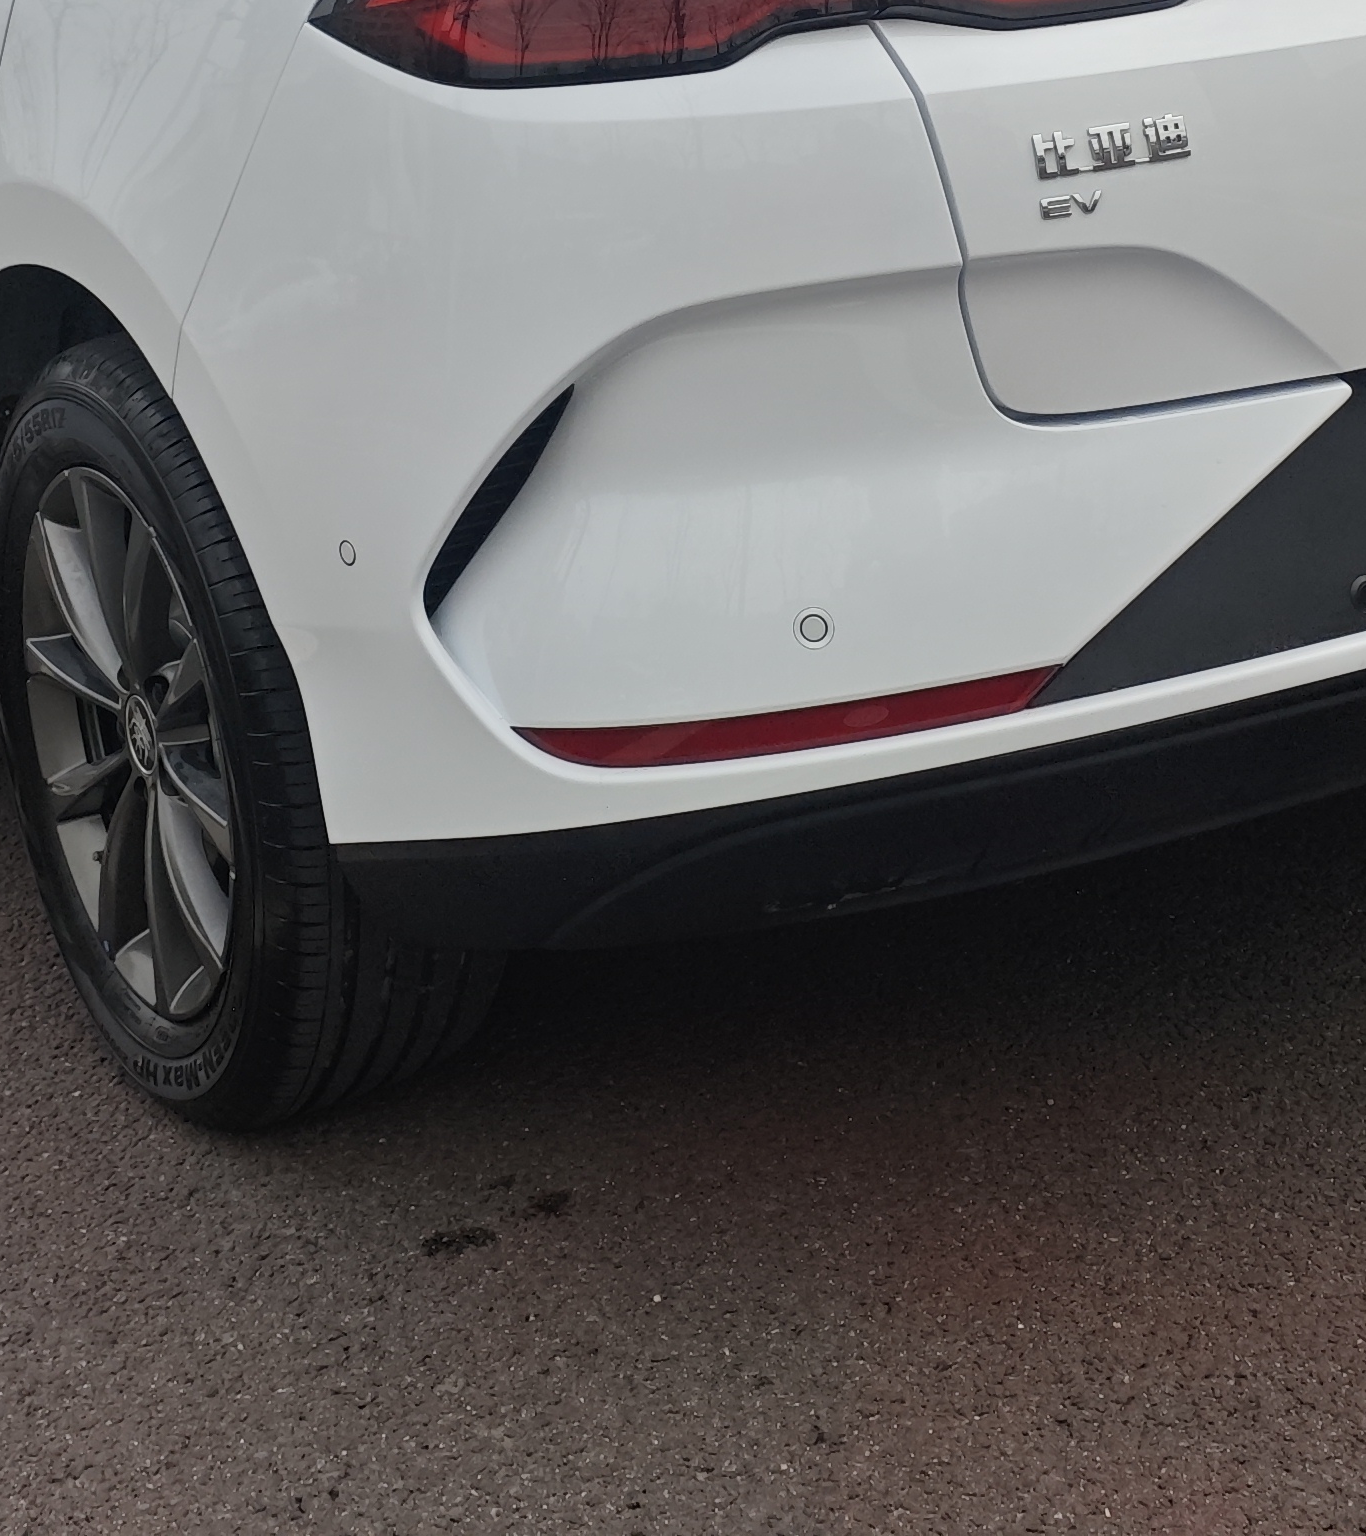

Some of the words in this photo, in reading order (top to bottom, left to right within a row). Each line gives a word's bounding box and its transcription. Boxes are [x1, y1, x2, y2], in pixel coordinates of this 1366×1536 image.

[1032, 113, 1192, 180] 比亚迪
[1040, 189, 1102, 221] EV
